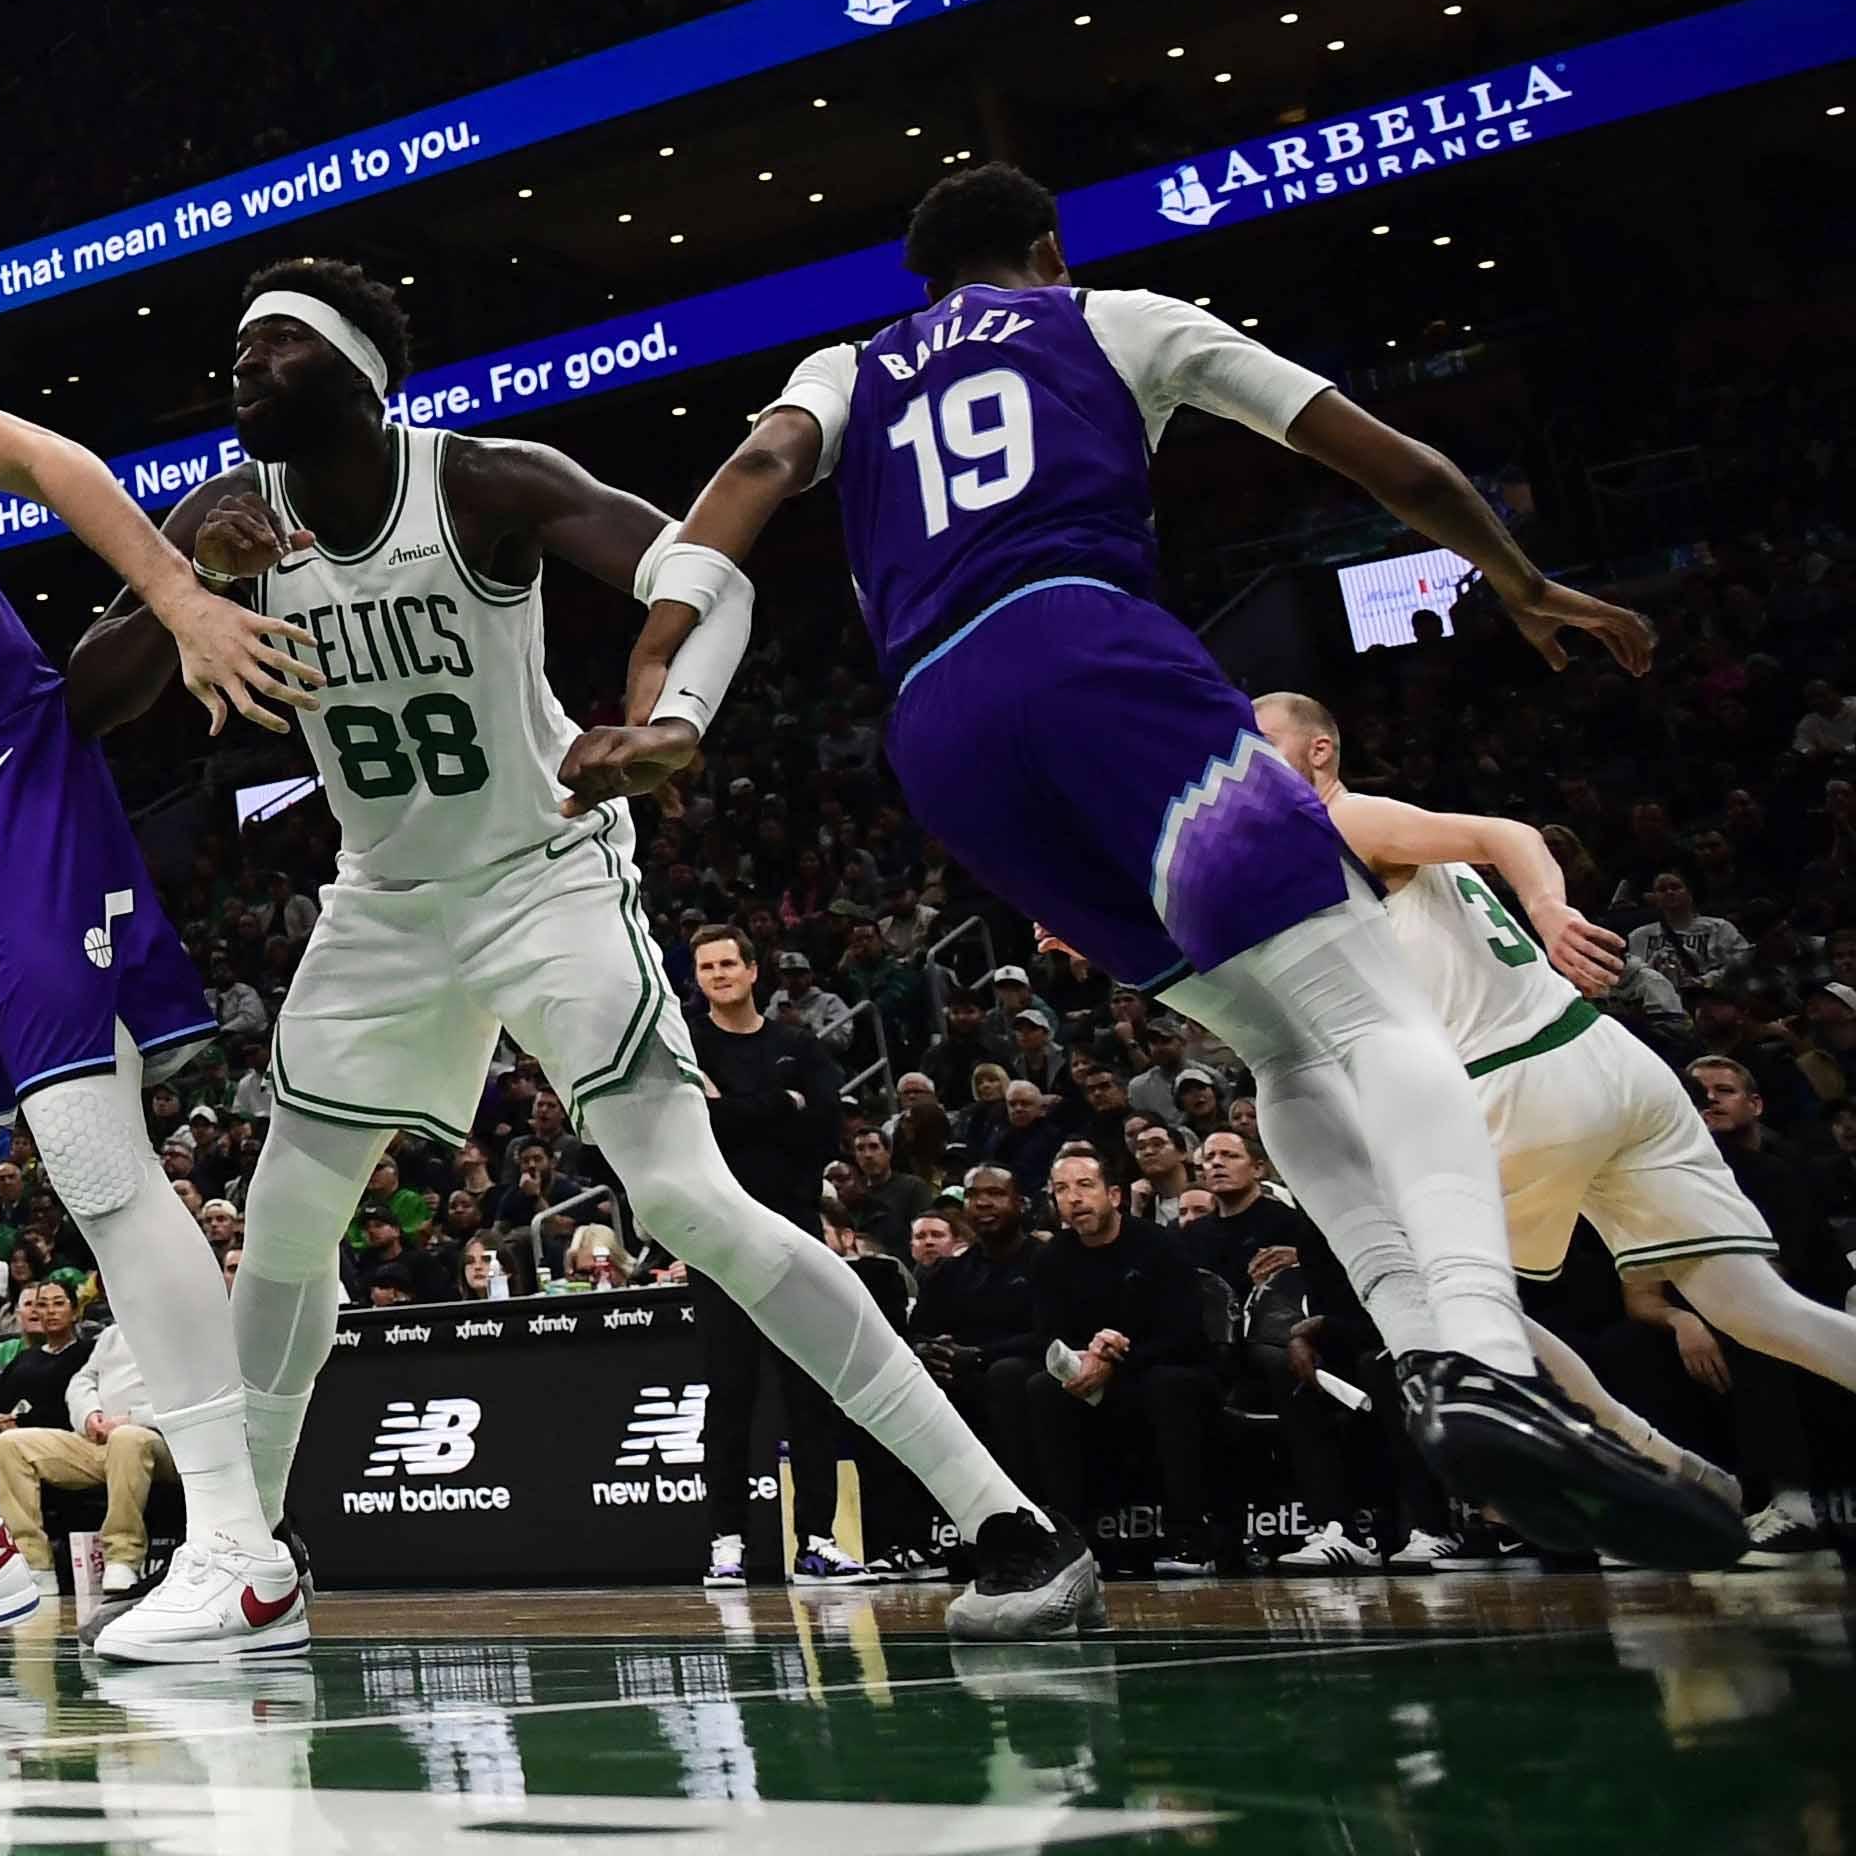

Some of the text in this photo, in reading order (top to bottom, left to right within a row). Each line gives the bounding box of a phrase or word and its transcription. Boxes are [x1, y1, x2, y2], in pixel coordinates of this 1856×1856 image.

[1216, 63, 1572, 192] ARBELLA
[1262, 118, 1533, 212] INSURANCE
[0, 248, 65, 297] that
[71, 223, 167, 274] mean
[175, 195, 233, 241] the
[240, 153, 343, 220] world
[351, 142, 391, 183] to
[397, 116, 481, 175] you.
[878, 307, 1036, 382] BAILEY
[386, 322, 679, 429] Here. For good.
[134, 450, 209, 498] New
[888, 366, 1037, 540] 19
[388, 542, 441, 565] Amica
[284, 593, 474, 692] CELTICS
[324, 692, 490, 800] 88
[385, 1324, 432, 1345] xfinity
[455, 1319, 504, 1341] xfinity
[528, 1314, 578, 1336] xfinity
[603, 1308, 654, 1330] xfinity
[343, 1483, 511, 1515] new balance
[592, 1479, 650, 1505] new
